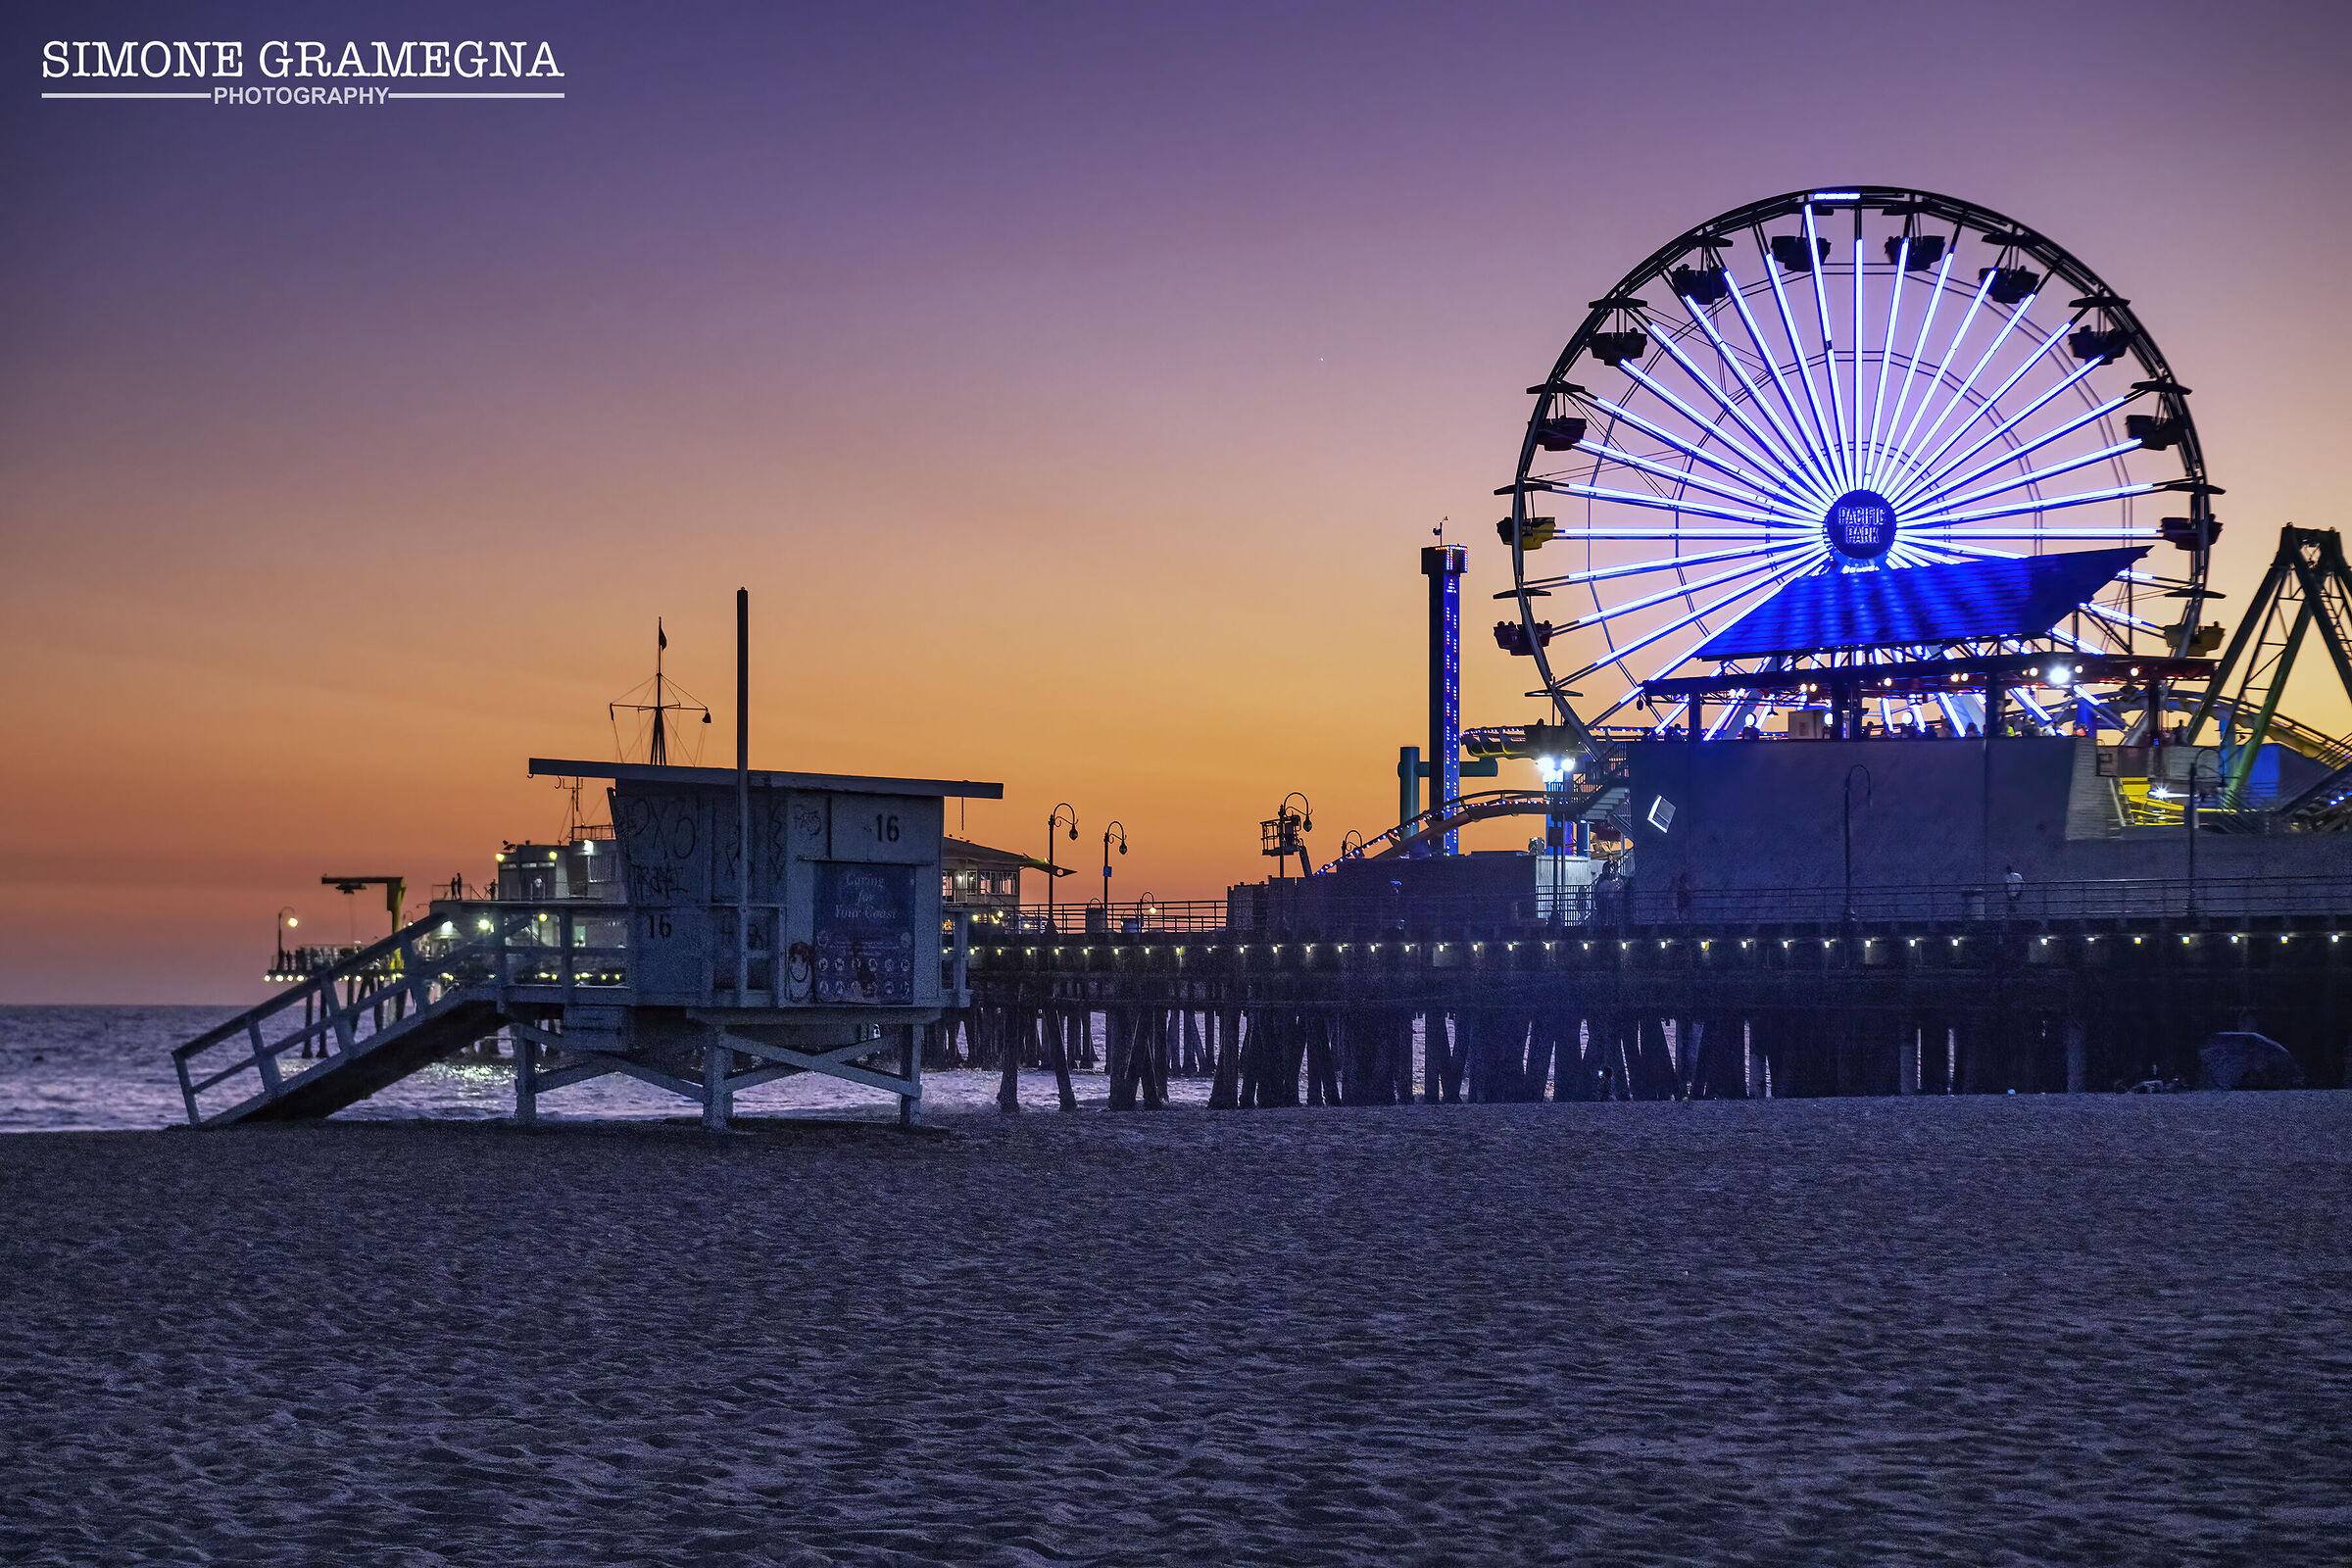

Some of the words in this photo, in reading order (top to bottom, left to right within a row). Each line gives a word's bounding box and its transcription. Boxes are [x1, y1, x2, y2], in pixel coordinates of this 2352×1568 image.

[1838, 507, 1886, 525] PACIFIC
[1845, 526, 1880, 544] PARK
[876, 813, 900, 842] 16
[846, 873, 885, 889] Caring
[835, 905, 861, 918] Your
[649, 914, 671, 939] 16
